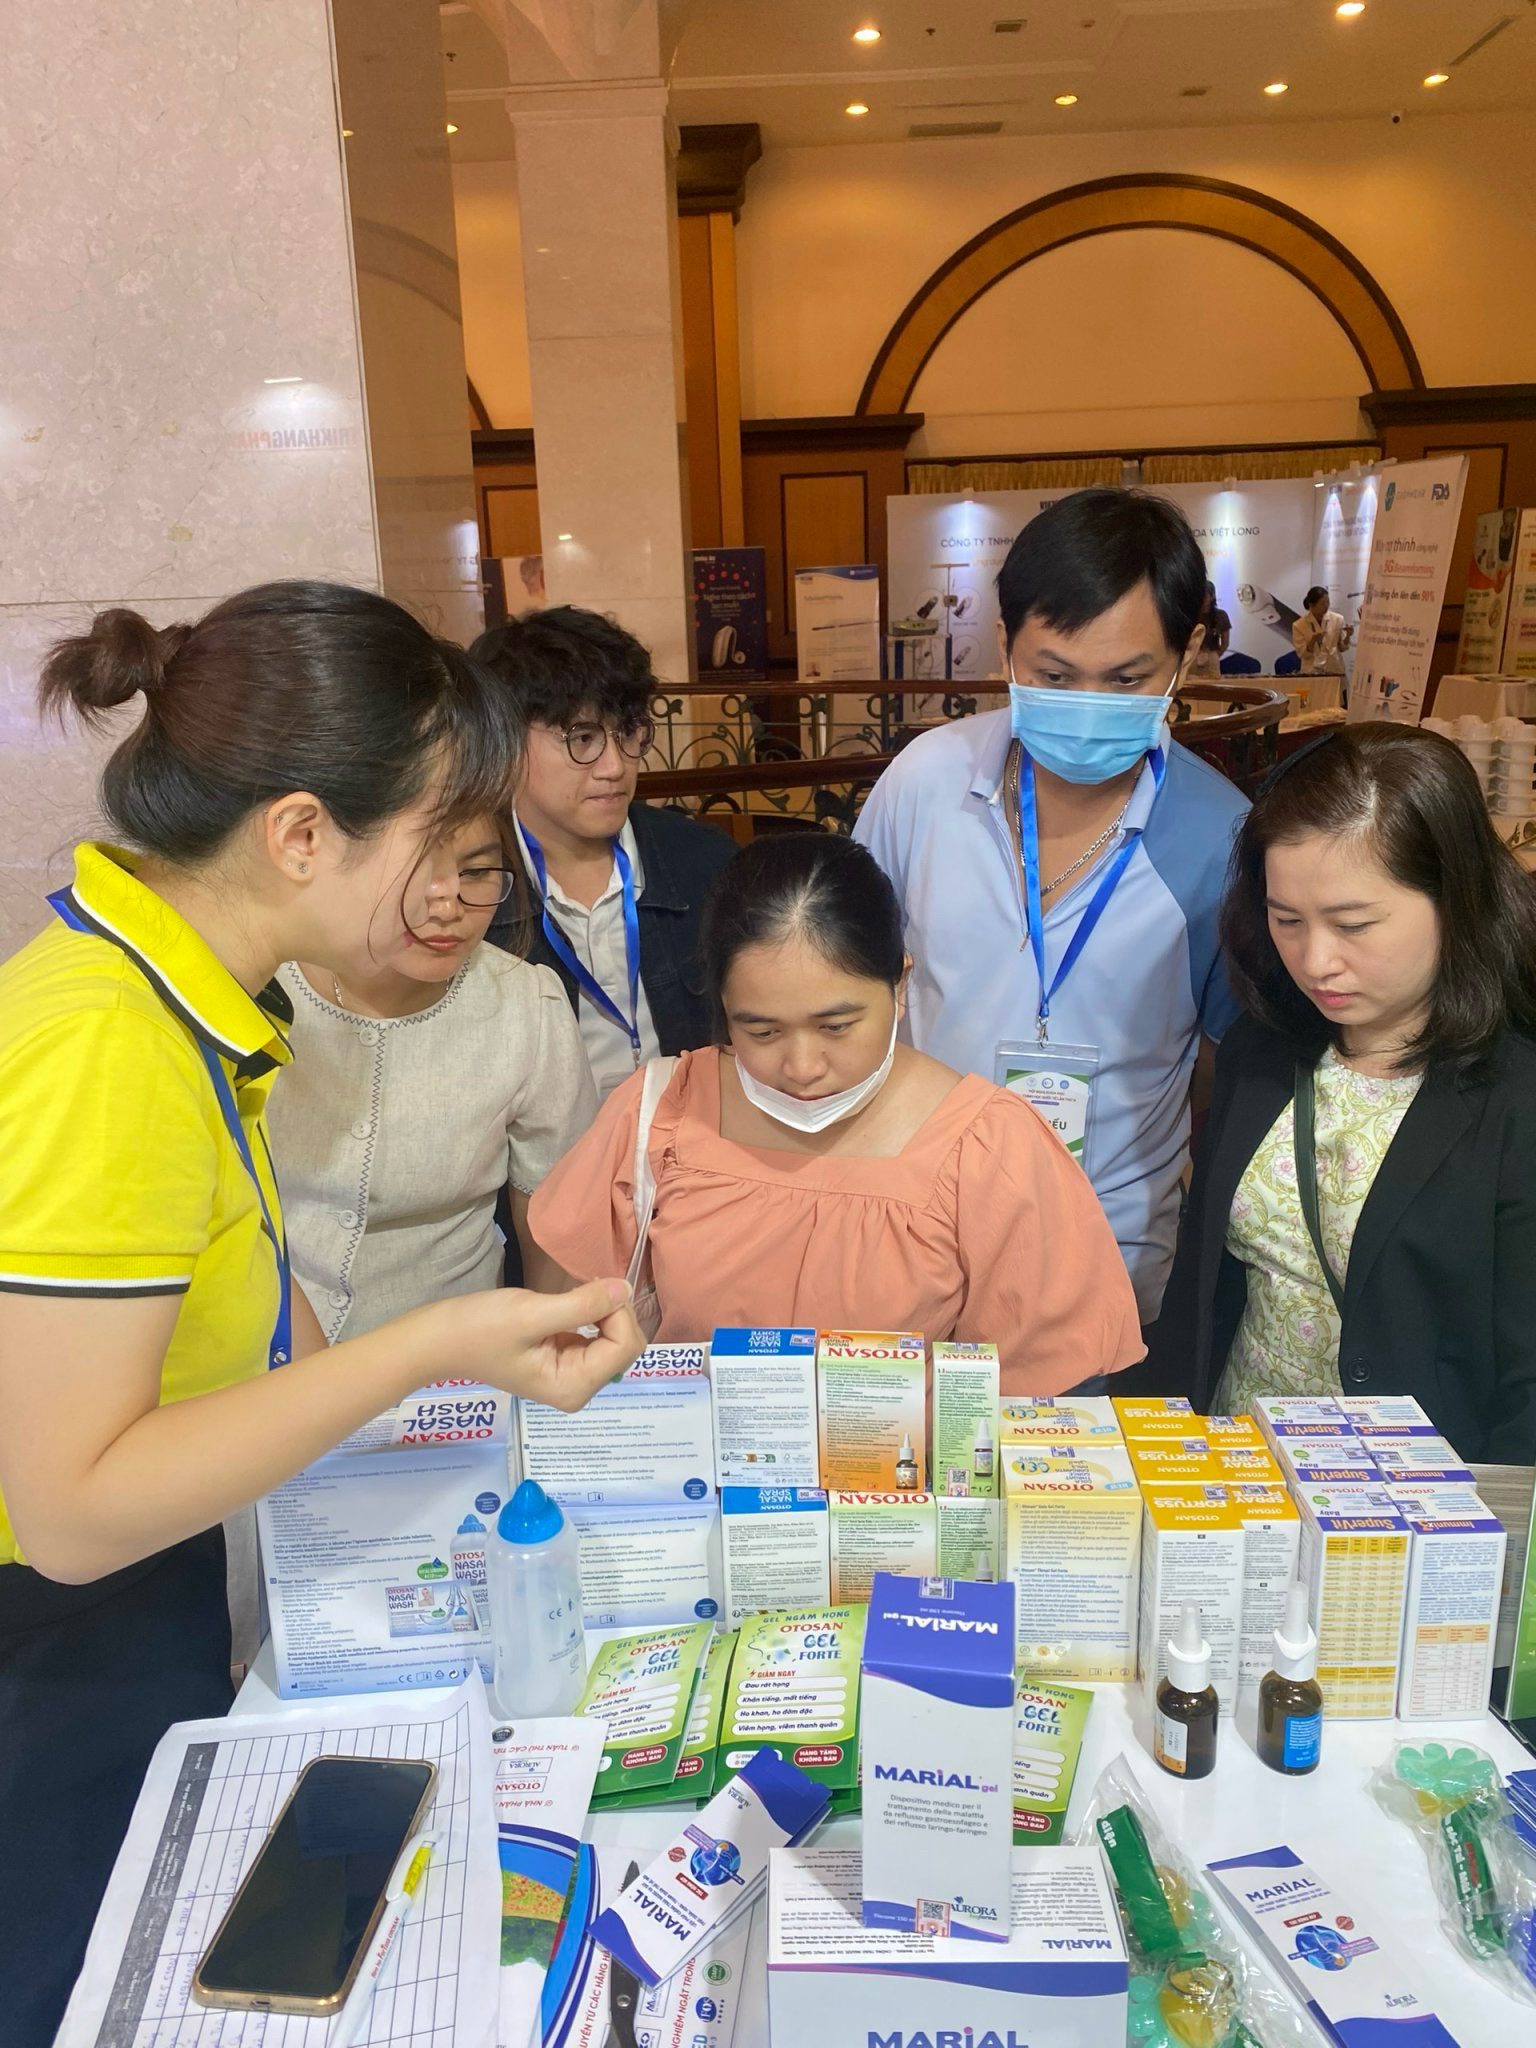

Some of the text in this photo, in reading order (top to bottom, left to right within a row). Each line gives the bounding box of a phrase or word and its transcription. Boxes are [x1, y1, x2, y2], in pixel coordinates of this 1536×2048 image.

[1209, 526, 1260, 538] VIỆT LONG
[940, 537, 1014, 549] CÔNG TY TNHH
[1048, 1117, 1067, 1131] ẾU
[828, 1348, 918, 1360] OTOSAN
[633, 1358, 702, 1369] NASAL
[630, 1369, 701, 1378] OTOSAN
[416, 1399, 497, 1417] WASH
[1124, 1409, 1191, 1419] FORTUSS
[402, 1413, 494, 1432] NASAL
[1013, 1427, 1080, 1435] OTOSAN
[1285, 1424, 1342, 1435] SuperVit
[402, 1429, 493, 1445] OTOSAN
[1138, 1452, 1209, 1461] FORTUSS
[1309, 1470, 1371, 1481] SuperVit
[1023, 1483, 1094, 1492] OTOSAN
[838, 1493, 929, 1505] OTOSAN
[1153, 1499, 1227, 1509] FORTUSS
[1331, 1519, 1396, 1531] SuperVit
[455, 1569, 486, 1580] WASH
[388, 1586, 415, 1595] OTOSAN
[388, 1593, 417, 1602] NASAL
[388, 1601, 414, 1610] WASH
[780, 1622, 844, 1633] OTOSAN
[617, 1641, 632, 1649] GEL
[803, 1633, 840, 1649] GEL
[630, 1637, 689, 1657] OTOSAN
[648, 1649, 681, 1665] GEL
[799, 1650, 841, 1661] FORTE
[641, 1660, 681, 1678] FORTE
[778, 1670, 796, 1678] NGAY
[745, 1681, 760, 1689] Đau
[760, 1680, 772, 1688] rát
[618, 1686, 636, 1697] NGAY
[783, 1694, 798, 1702] mất
[798, 1693, 817, 1703] tiếng
[740, 1710, 750, 1718] Ho
[751, 1709, 770, 1718] khan,
[1023, 1705, 1062, 1724] GEL
[629, 1727, 648, 1736] thanh
[738, 1724, 756, 1732] Viêm
[778, 1722, 796, 1730] viêm
[797, 1722, 818, 1730] thanh
[1017, 1720, 1063, 1737] FORTE
[800, 1749, 819, 1757] HÀNG
[799, 1755, 838, 1764] KHÔNG BÁN
[495, 1782, 541, 1791] OTOSAN
[981, 1784, 999, 1793] gel
[890, 1794, 931, 1806] Dispositivo
[932, 1799, 961, 1808] medico
[887, 1802, 985, 1820] trattamento della malattia
[894, 1811, 924, 1821] reflusso
[924, 1815, 982, 1828] gastroesofageo
[883, 1818, 988, 1836] del reflusso laringo-faringeo
[683, 1957, 697, 1988] TRONG
[590, 1991, 601, 2011] CÁC
